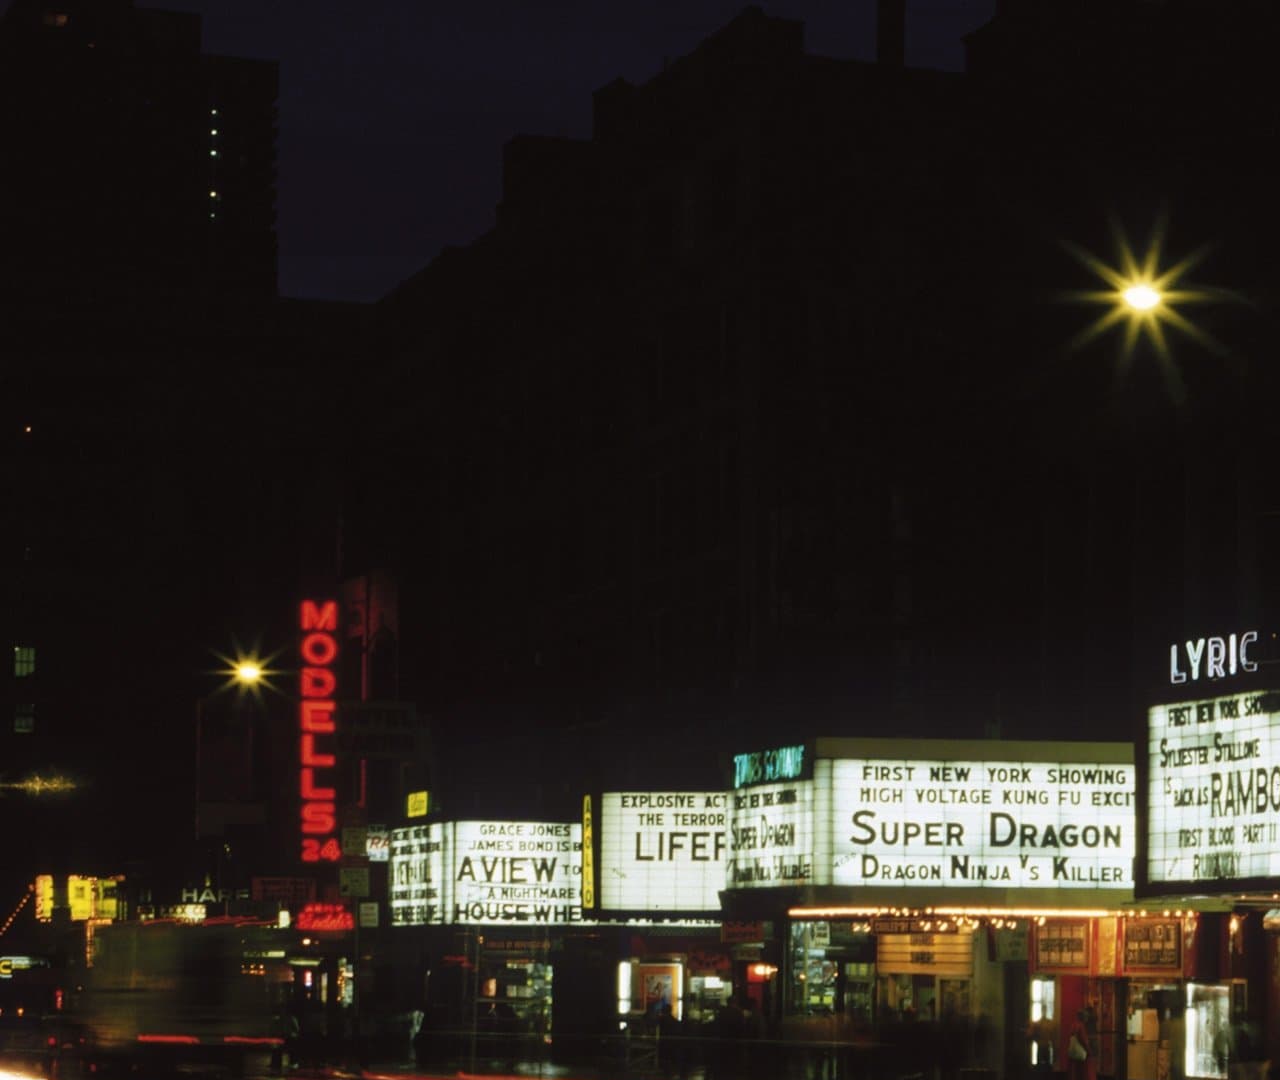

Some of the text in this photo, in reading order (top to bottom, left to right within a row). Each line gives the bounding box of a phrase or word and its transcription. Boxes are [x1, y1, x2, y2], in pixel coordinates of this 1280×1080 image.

[1170, 631, 1259, 684] LYRIC
[299, 598, 340, 835] MODELLS
[1168, 707, 1191, 728] FIRST
[1160, 732, 1260, 767] SYLVESTER STALLONE
[862, 766, 1126, 785] FIRST NEW YORK SHOWING
[621, 795, 695, 809] EXPLOSIVE
[861, 787, 903, 804] HIGH
[915, 788, 992, 805] VOLTAGE
[1003, 789, 1049, 805] KUNG
[1059, 790, 1081, 806] FU
[637, 813, 725, 826] THE TERROR
[479, 824, 571, 837] GRACE JONES
[850, 810, 1121, 849] SUPER DRAGON
[301, 838, 341, 863] 24
[469, 840, 513, 851] JAMES
[519, 841, 554, 851] BOND
[557, 842, 570, 852] IS
[861, 854, 941, 881] DRAGON
[950, 854, 1011, 881] NINJA
[1052, 855, 1123, 882] KILLER
[502, 887, 576, 899] NIGHTMARE
[456, 903, 529, 921] HOUSE
